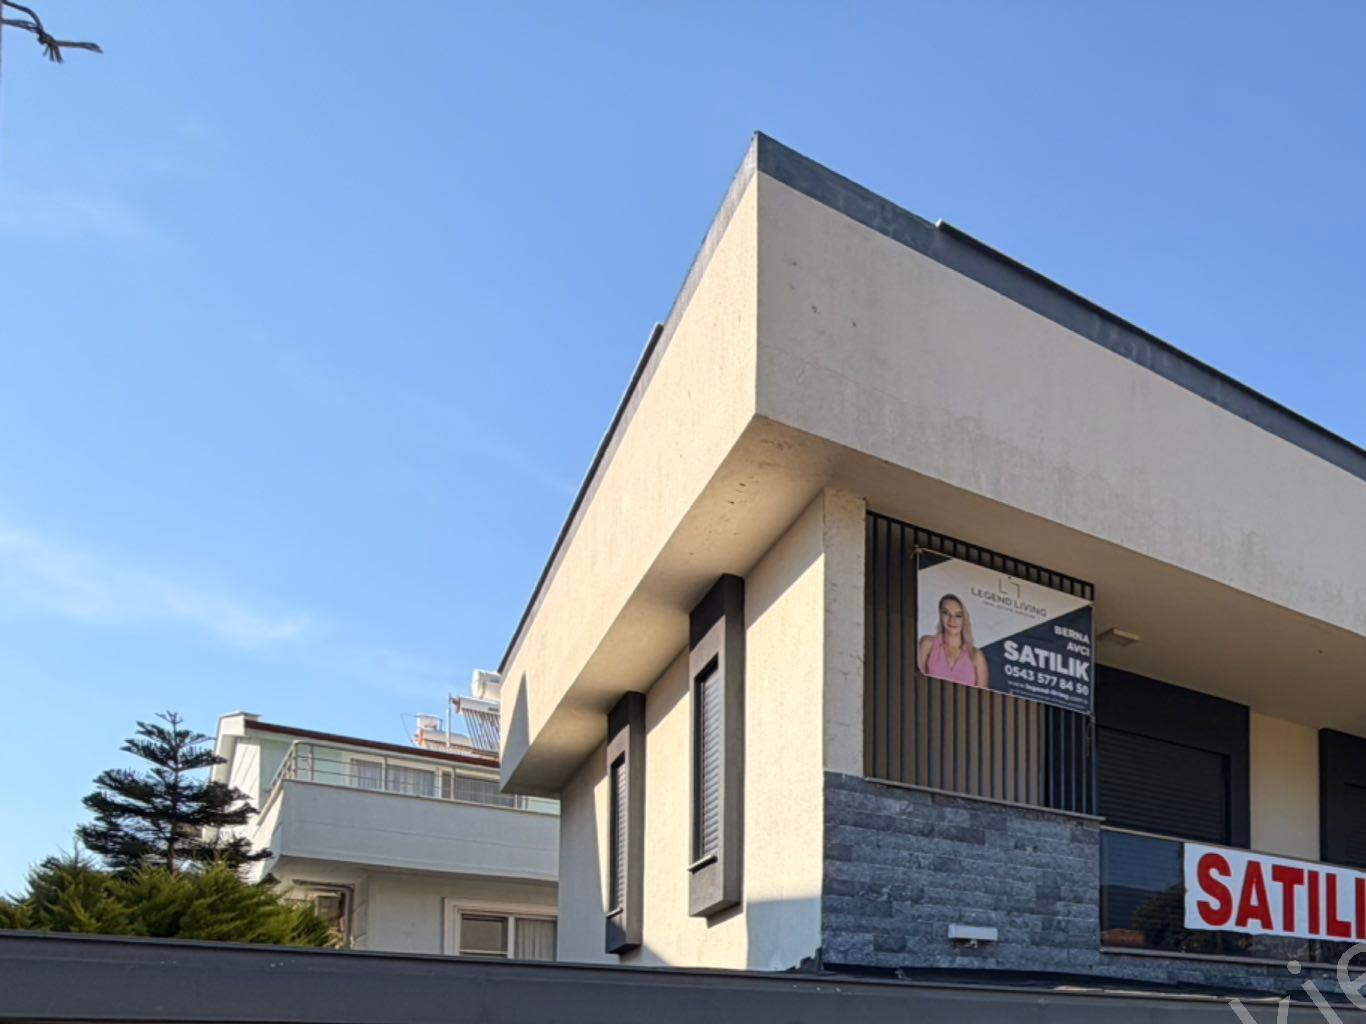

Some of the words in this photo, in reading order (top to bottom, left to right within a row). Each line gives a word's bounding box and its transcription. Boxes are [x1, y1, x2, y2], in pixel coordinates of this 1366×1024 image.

[971, 587, 1012, 607] LEGEND
[1014, 599, 1047, 617] LIVING
[1054, 625, 1090, 645] BERNA
[1003, 639, 1090, 682] SATILIK
[1004, 664, 1035, 681] 0543
[1037, 672, 1058, 686] 577
[1059, 678, 1074, 691] 84
[1075, 683, 1089, 696] 50
